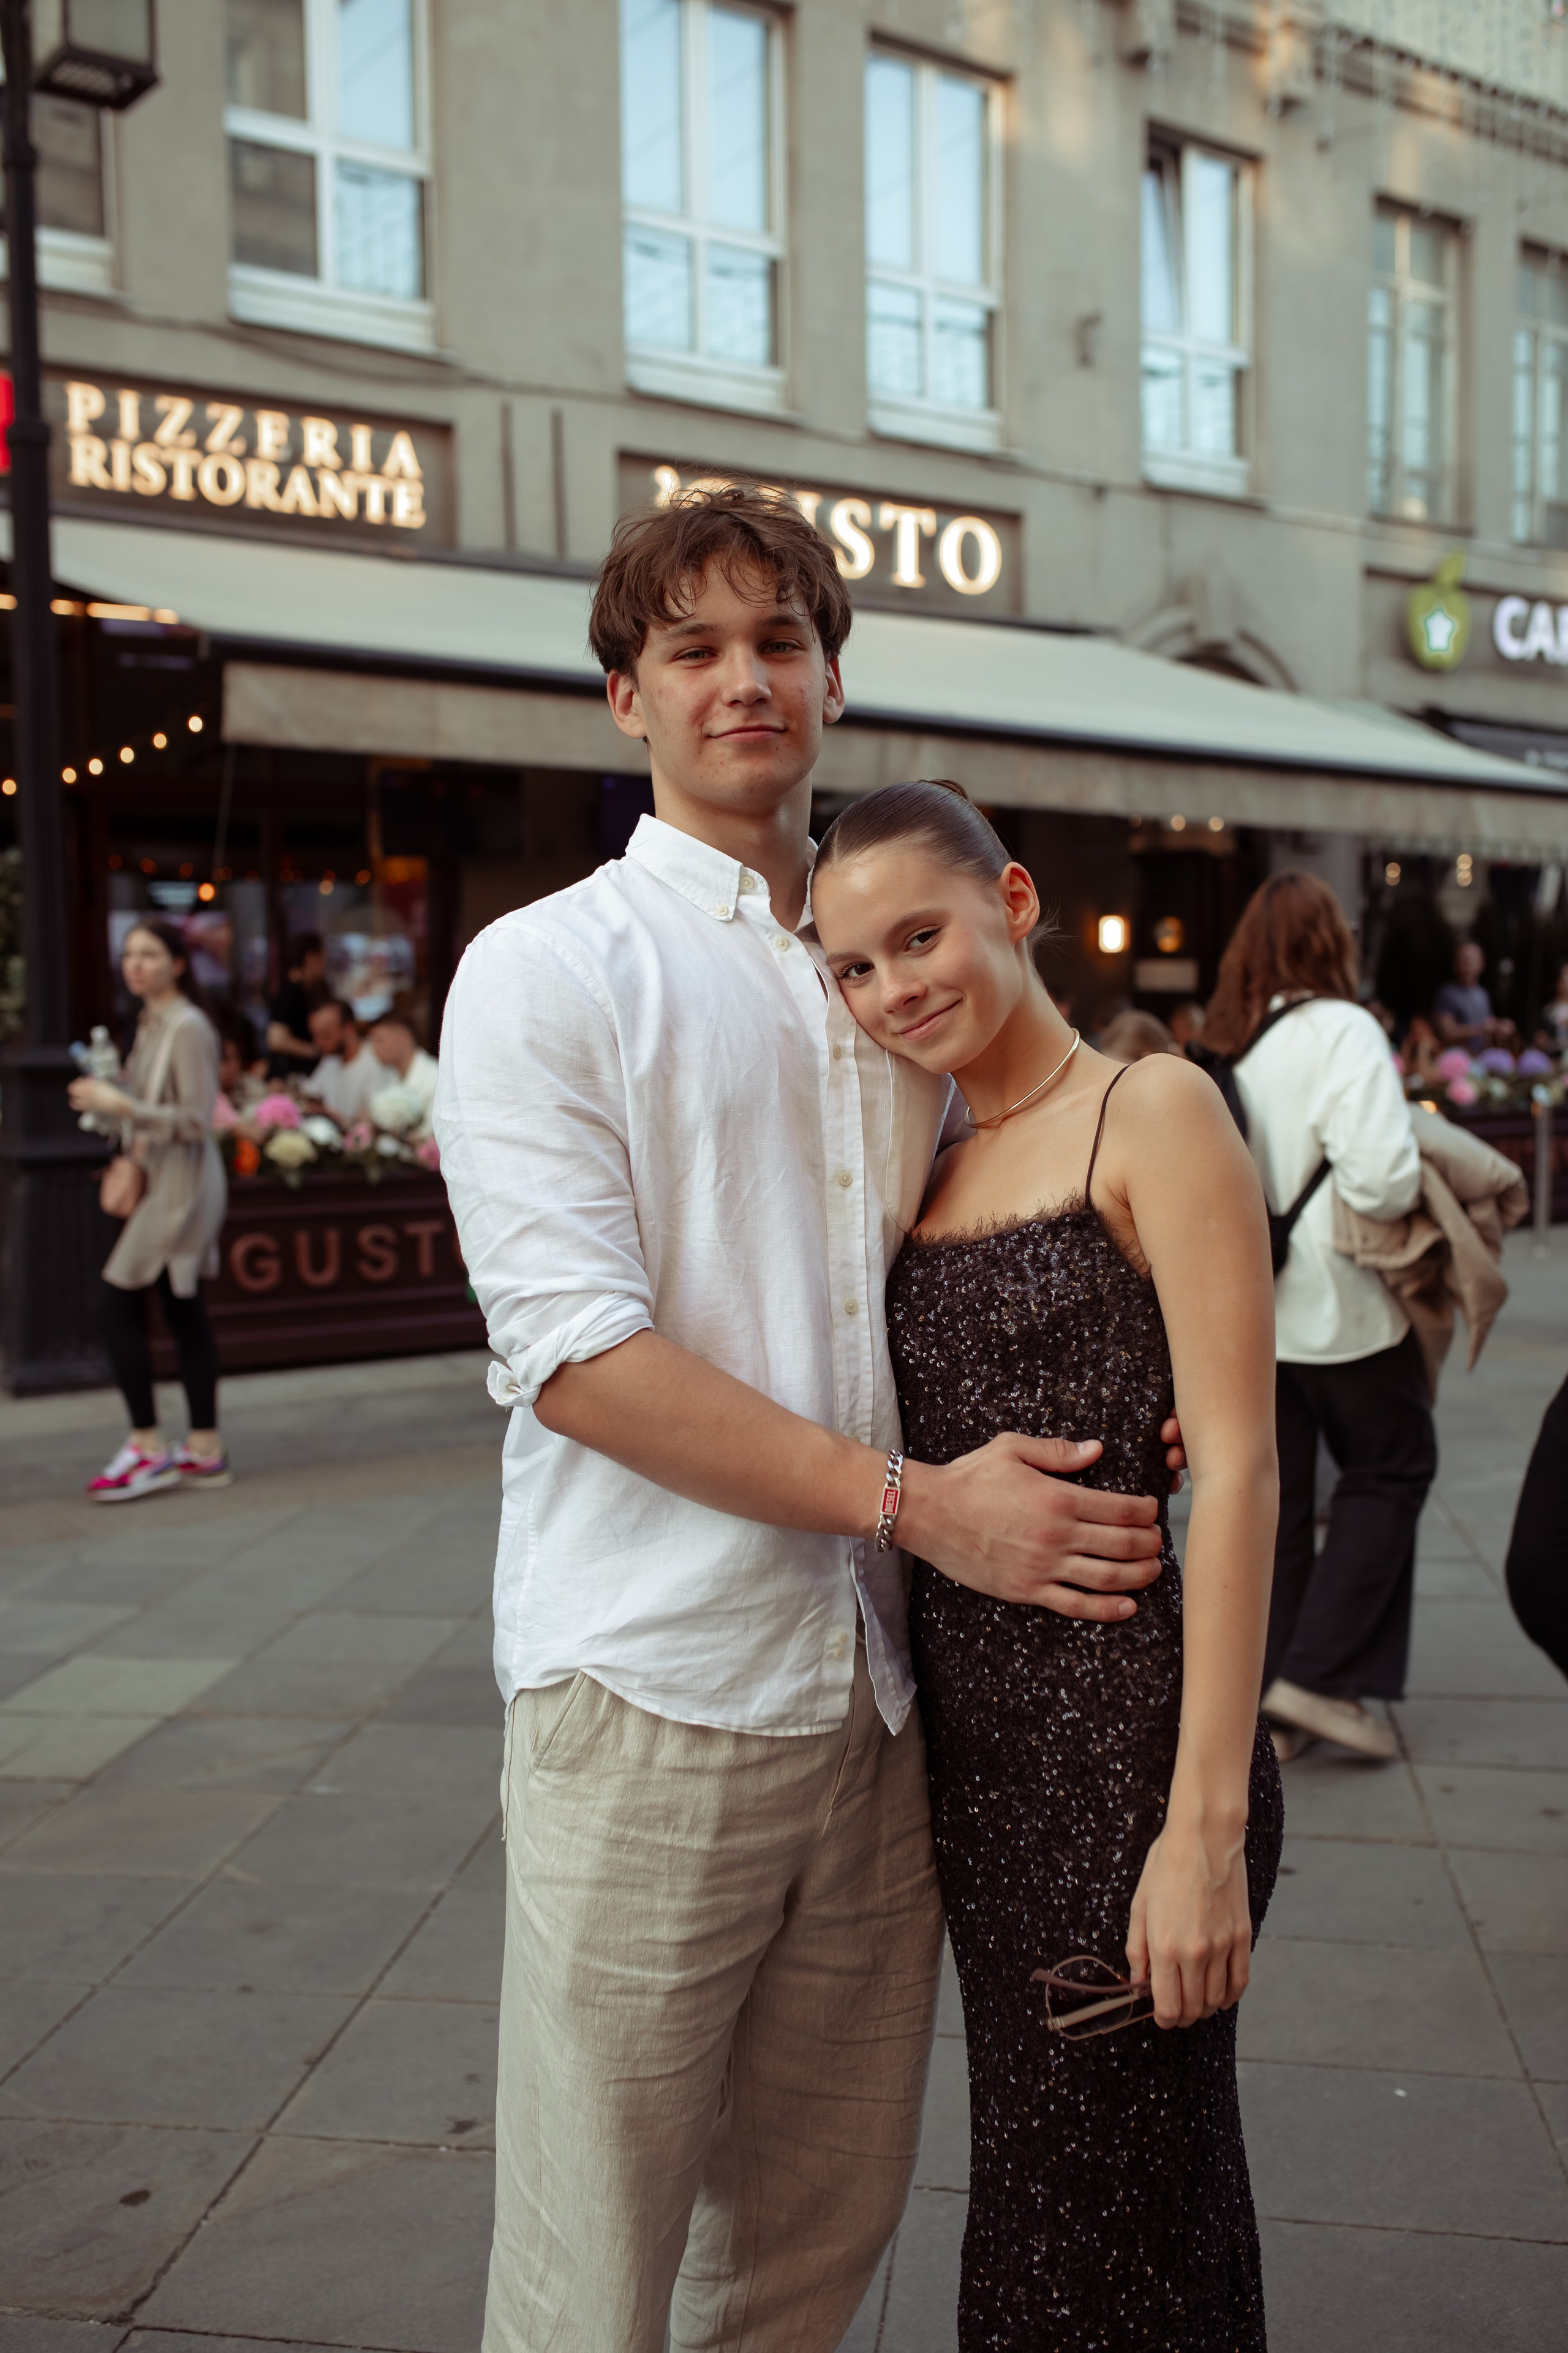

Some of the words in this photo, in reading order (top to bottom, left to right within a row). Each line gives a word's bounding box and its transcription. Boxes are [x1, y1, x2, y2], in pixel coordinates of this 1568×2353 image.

[65, 380, 423, 480] PIZZERIA
[69, 432, 426, 529] RISTORANTE
[1493, 595, 1568, 665] CA
[230, 1220, 467, 1293] GUST
[884, 1490, 895, 1513] DIESEL
